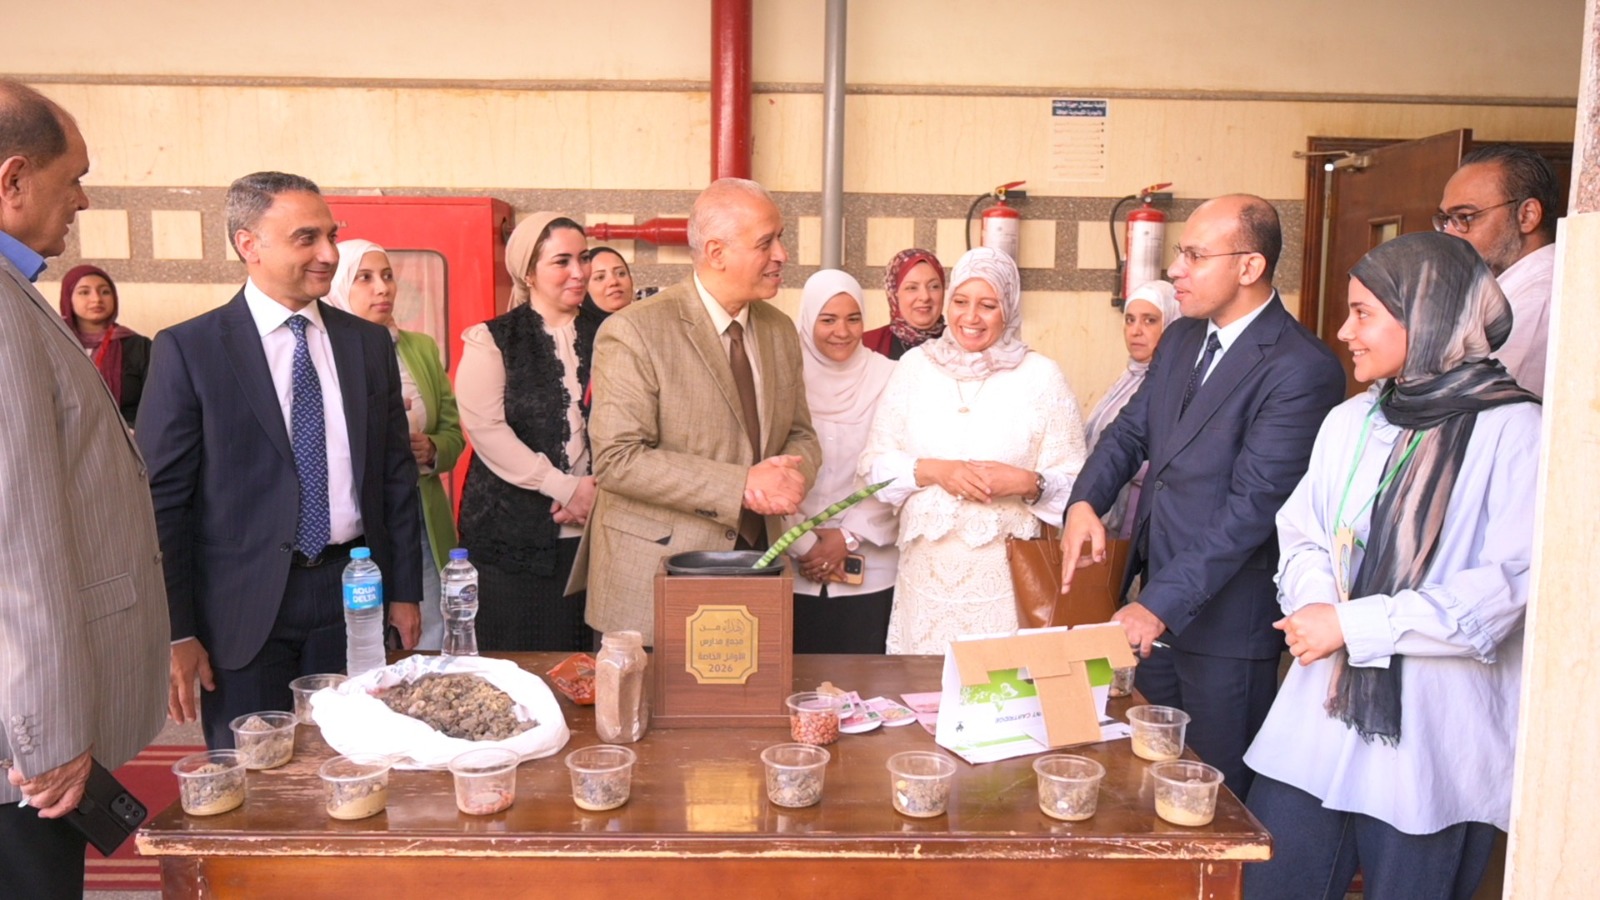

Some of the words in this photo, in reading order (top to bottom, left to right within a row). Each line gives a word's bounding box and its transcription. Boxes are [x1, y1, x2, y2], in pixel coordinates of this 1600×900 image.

[352, 585, 376, 594] AQUA
[352, 594, 377, 603] DELTA
[700, 637, 723, 647] مدارس
[725, 638, 744, 647] مجمع
[708, 664, 733, 673] 2026
